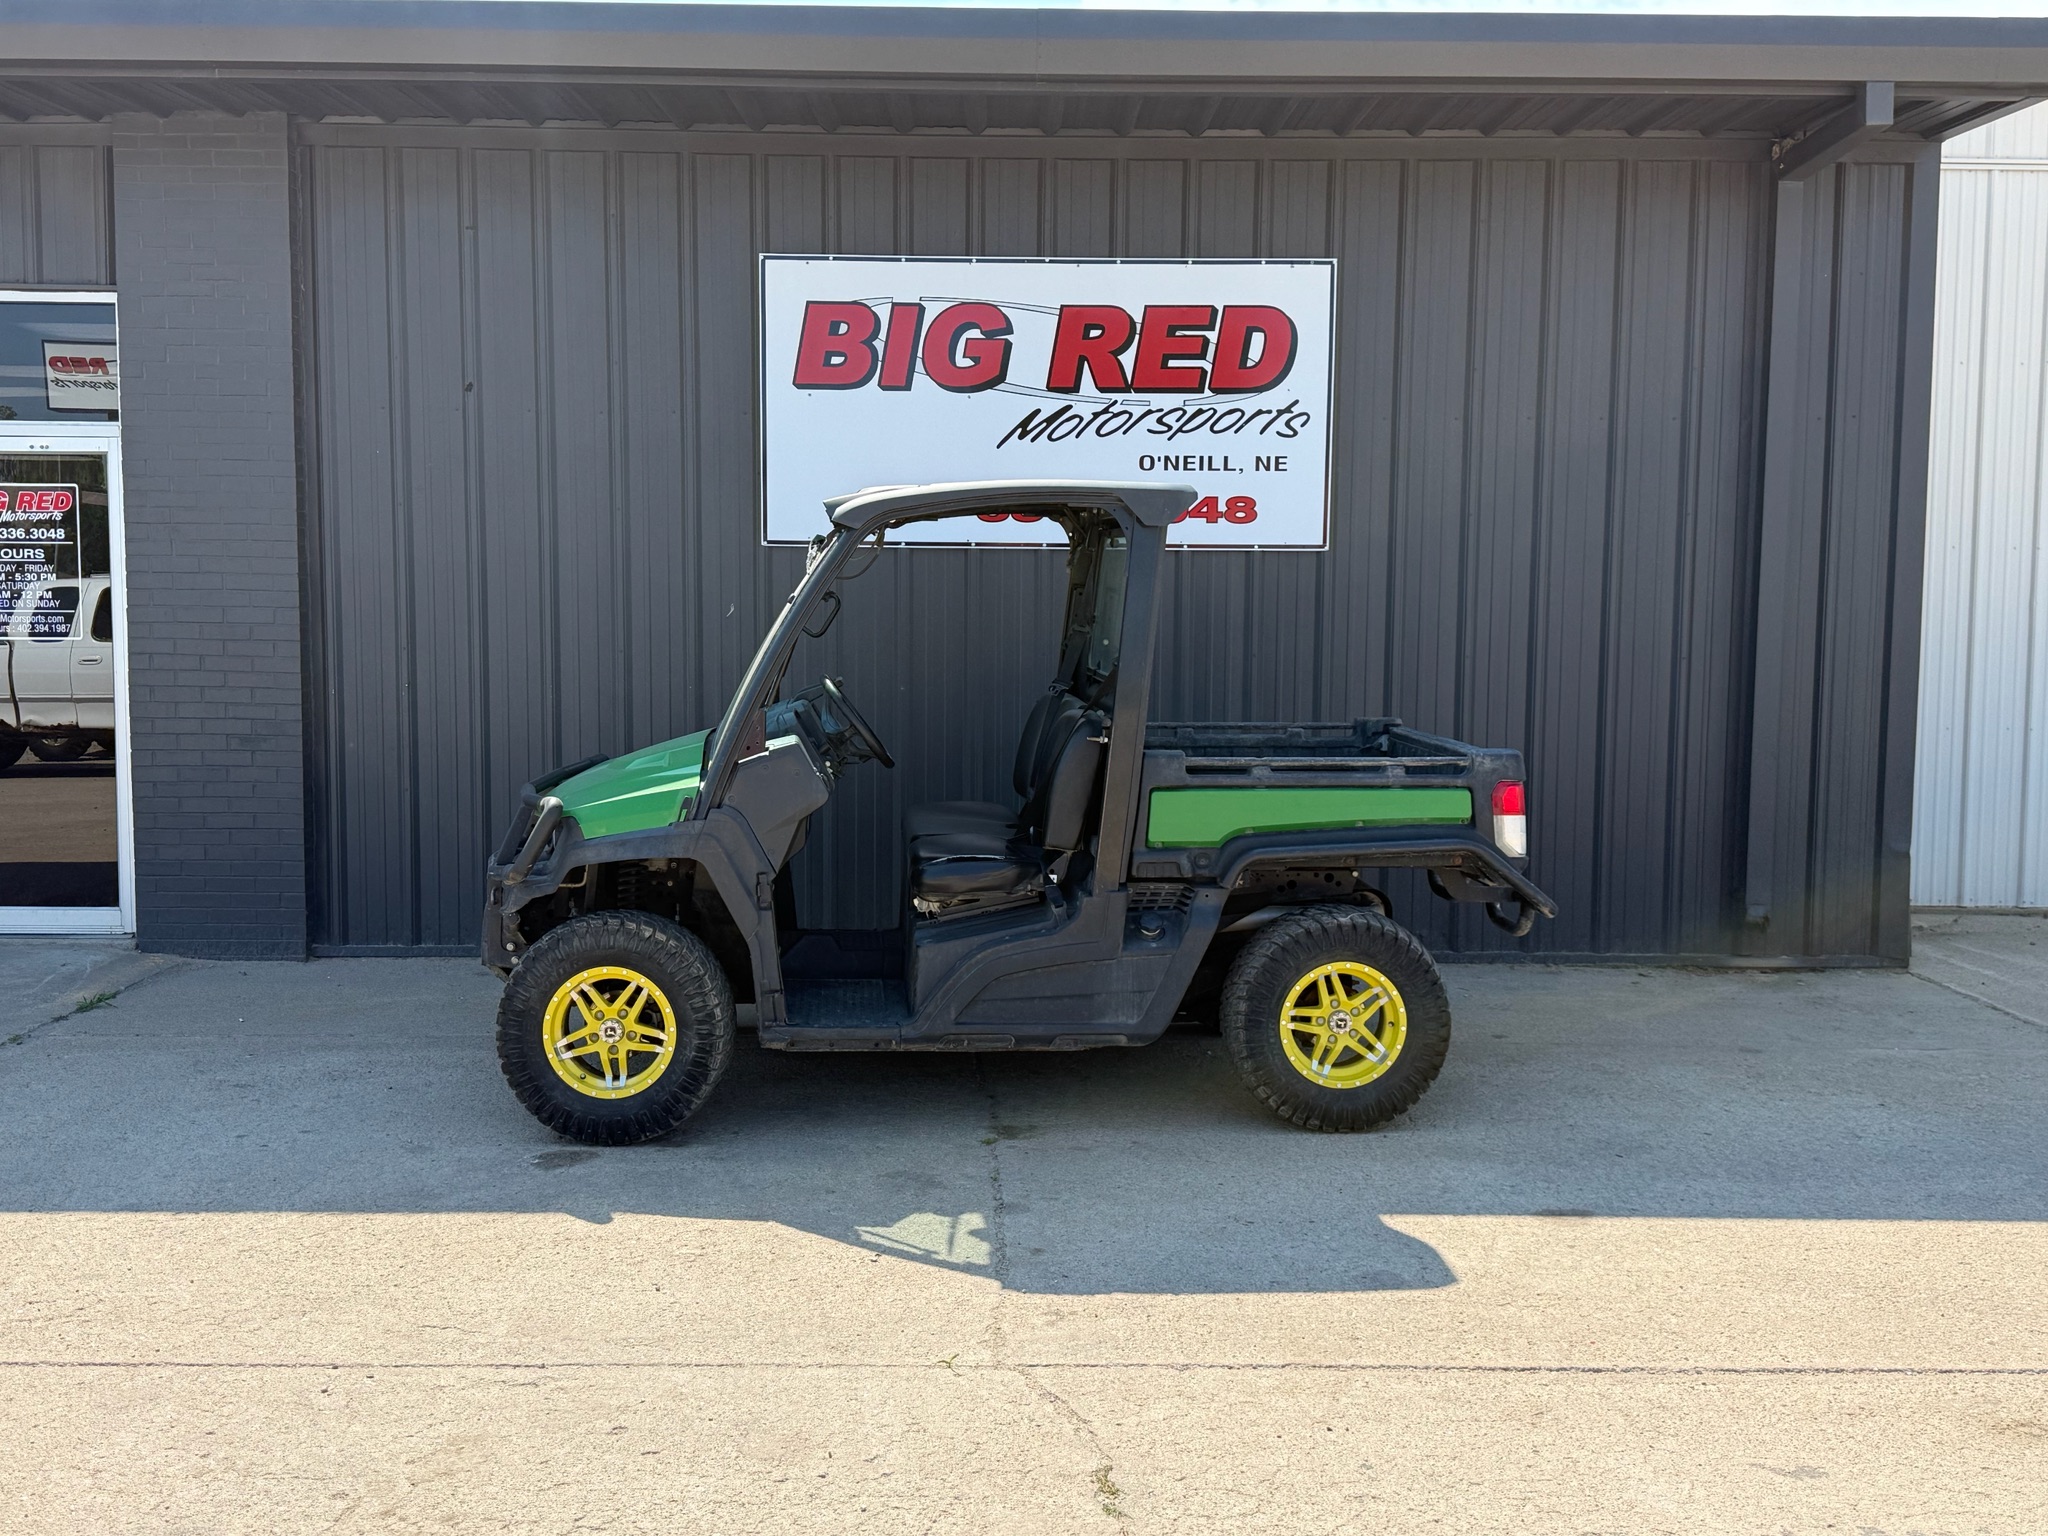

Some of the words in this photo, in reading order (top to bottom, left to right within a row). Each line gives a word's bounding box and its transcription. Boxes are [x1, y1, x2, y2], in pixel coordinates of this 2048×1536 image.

[792, 301, 1014, 393] BIG
[1046, 304, 1298, 393] RED
[996, 399, 1311, 449] Motorsports
[1139, 455, 1243, 474] O'NEILL,
[1255, 456, 1288, 471] NE
[15, 491, 73, 511] RED
[0, 510, 63, 523] Motorsports
[1, 548, 45, 559] OURS
[24, 564, 55, 572] FRIDAY
[15, 573, 37, 581] 5:30
[40, 573, 56, 581] PM
[0, 582, 41, 590] ATURDAY
[26, 600, 61, 608] SUNDAY
[0, 614, 65, 623] Motorsports.com
[17, 624, 71, 633] 402.394.1987
